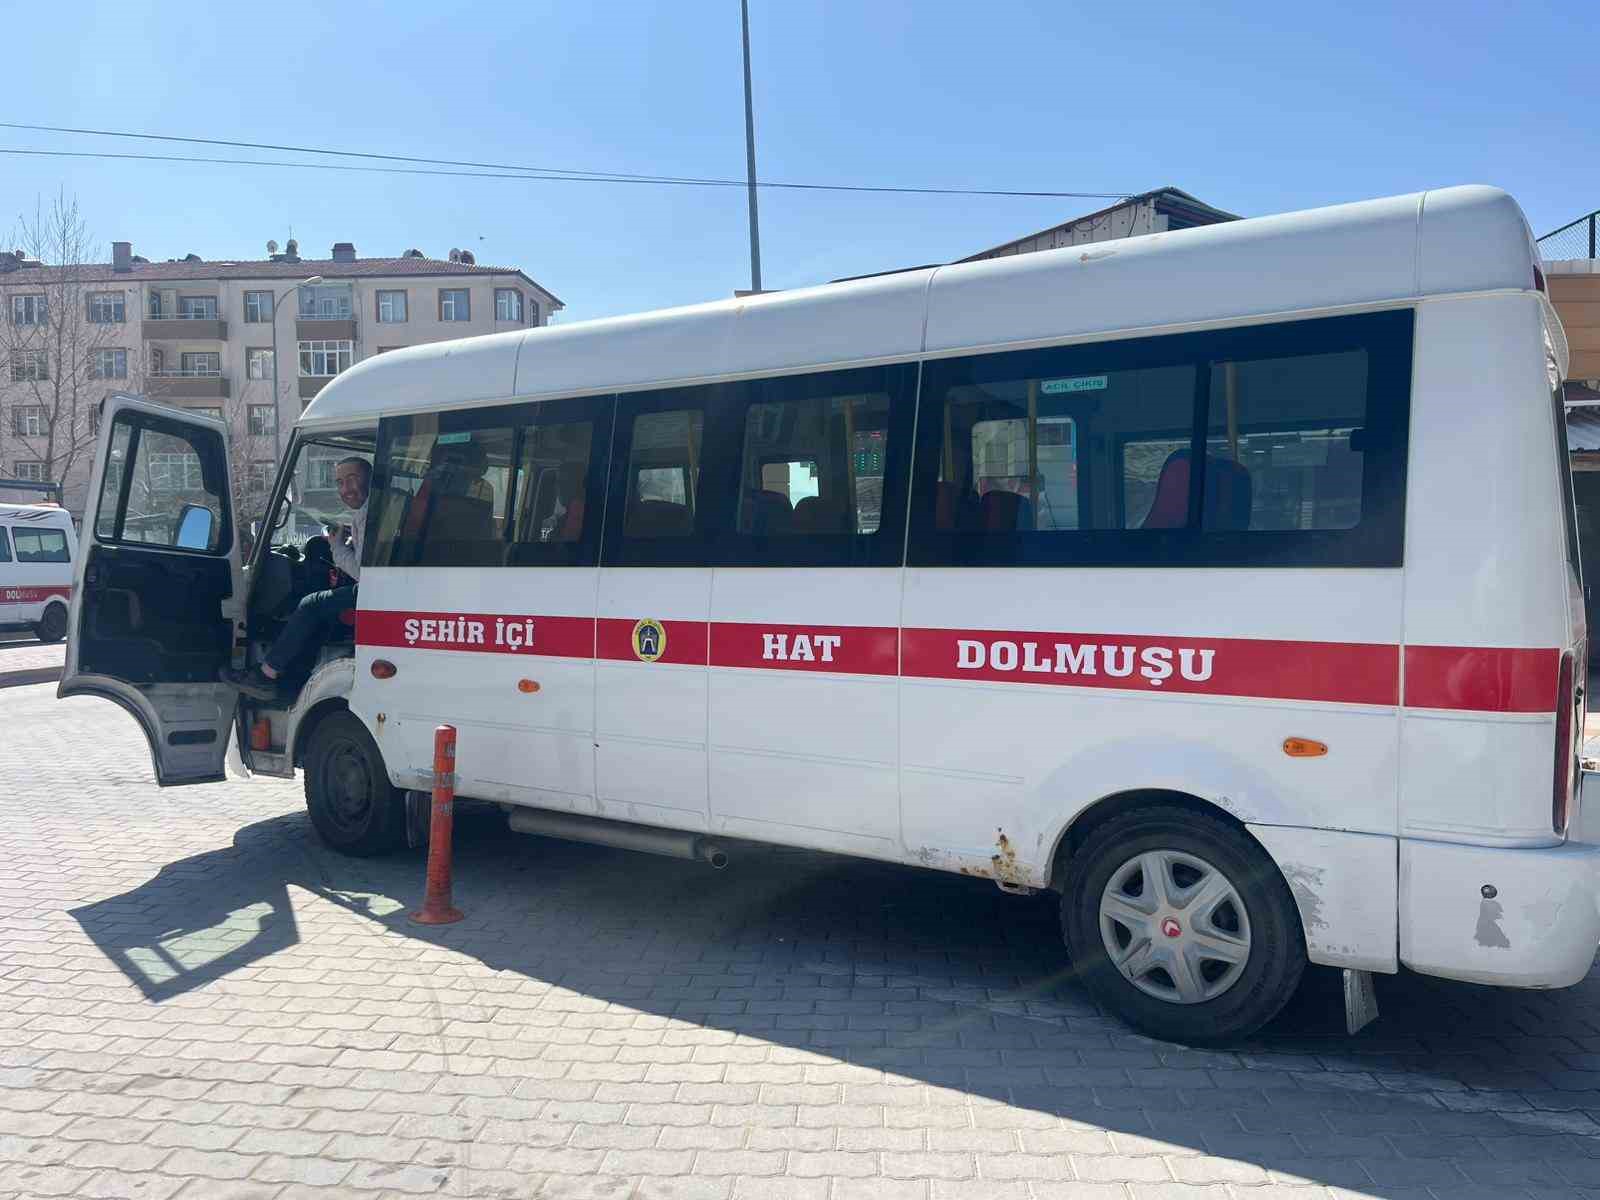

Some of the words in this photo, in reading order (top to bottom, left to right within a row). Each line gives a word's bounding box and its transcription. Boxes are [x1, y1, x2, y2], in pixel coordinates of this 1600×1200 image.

[404, 616, 485, 645] ŞEHİR
[495, 617, 535, 651] İÇİ
[762, 633, 841, 662] HAT
[956, 639, 1216, 686] DOLMUŞU
